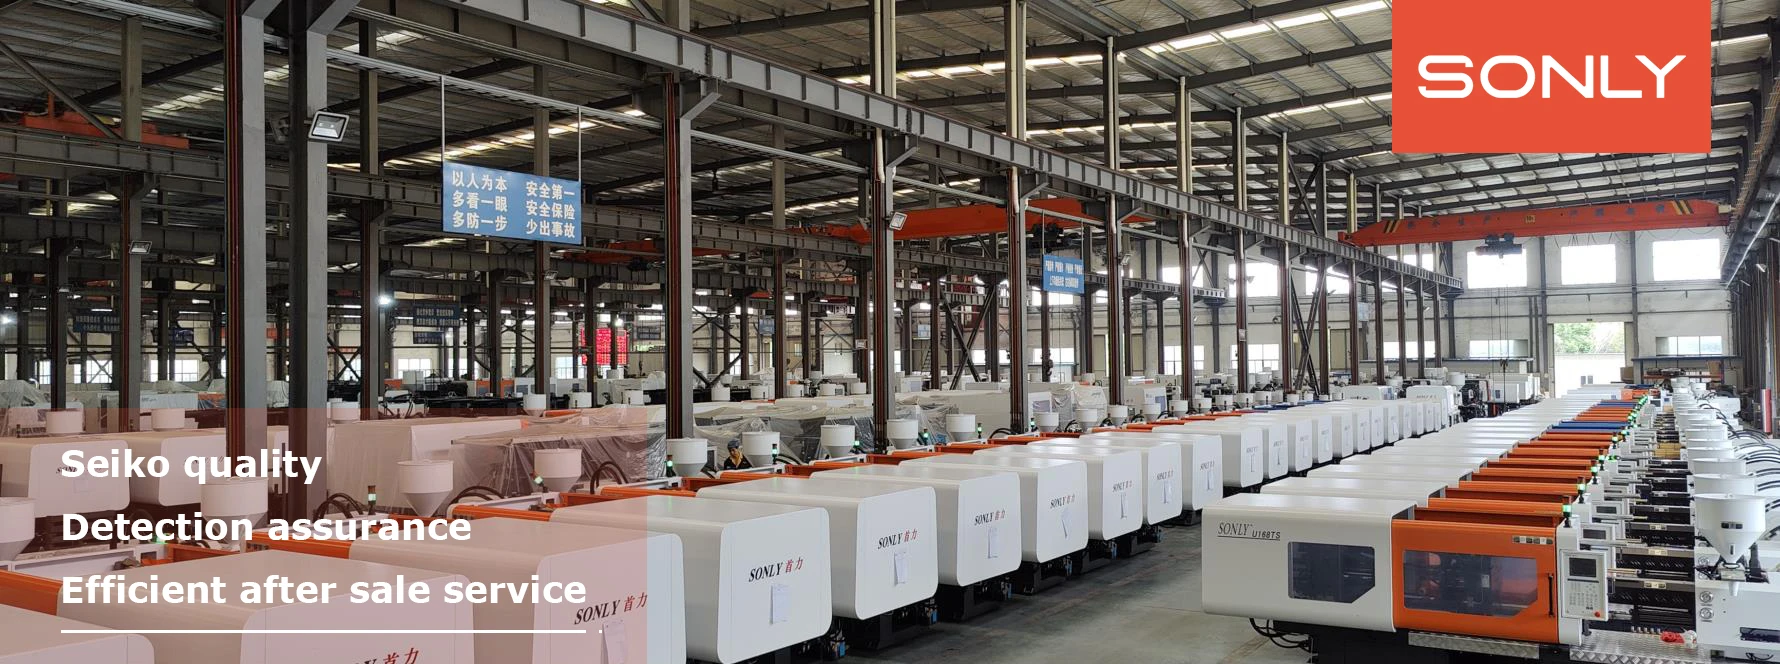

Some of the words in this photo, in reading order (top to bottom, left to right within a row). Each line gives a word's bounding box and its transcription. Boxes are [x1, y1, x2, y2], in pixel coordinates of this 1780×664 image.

[452, 170, 508, 193] 以人为本
[526, 181, 575, 200] 安全第一
[452, 190, 508, 212] 多看一眼
[526, 200, 575, 220] 安全保险
[452, 210, 508, 232] 多防一步
[526, 219, 575, 238] 少出事故
[1217, 522, 1248, 536] SONLY
[1251, 530, 1281, 539] U168TS
[877, 532, 903, 550] SONLY
[748, 561, 783, 582] SONLY
[574, 599, 621, 625] SONLY
[623, 592, 648, 613] 首力
